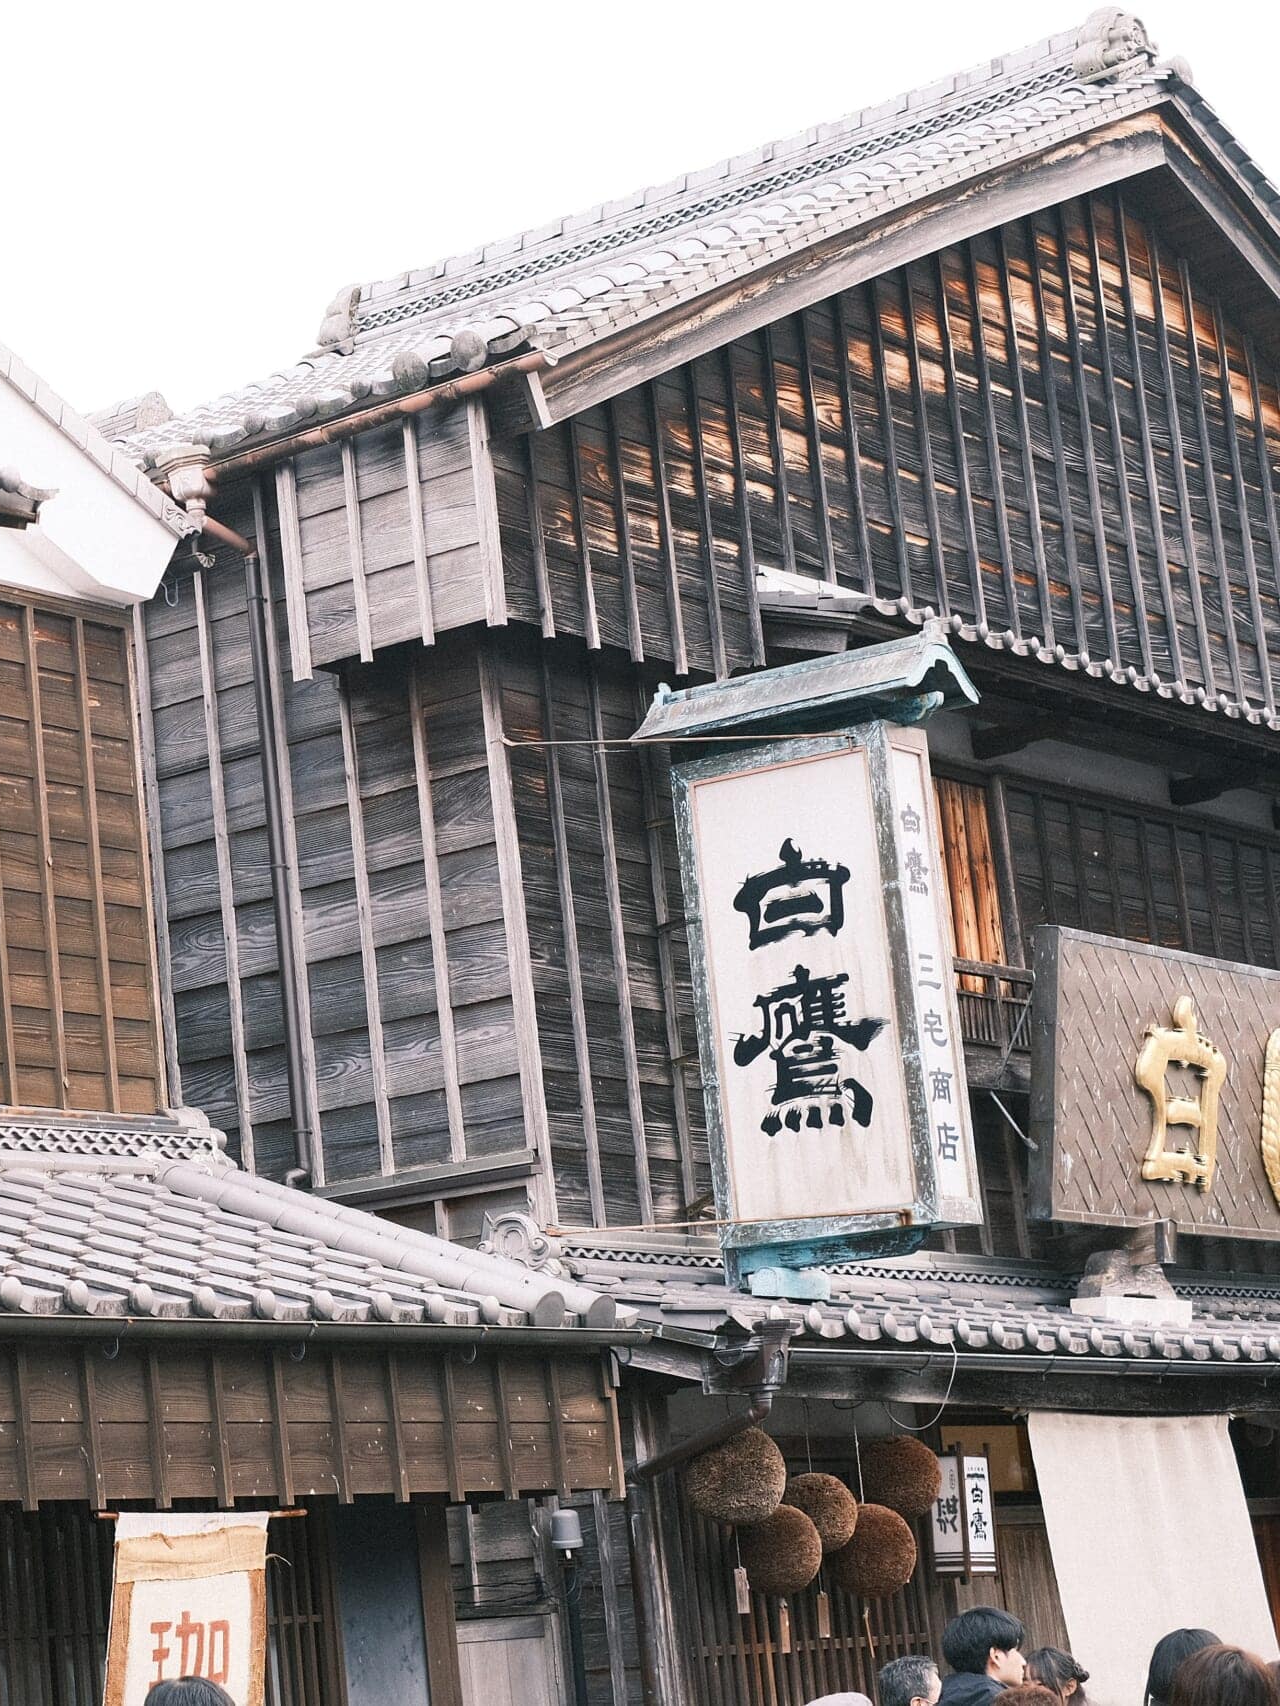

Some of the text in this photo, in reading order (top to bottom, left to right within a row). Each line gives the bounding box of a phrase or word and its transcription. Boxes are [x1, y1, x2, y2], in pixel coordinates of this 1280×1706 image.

[728, 837, 890, 1137] 白鷹
[918, 953, 960, 1162] 三宅商店
[1135, 995, 1280, 1213] 白
[149, 1611, 230, 1691] 珈
